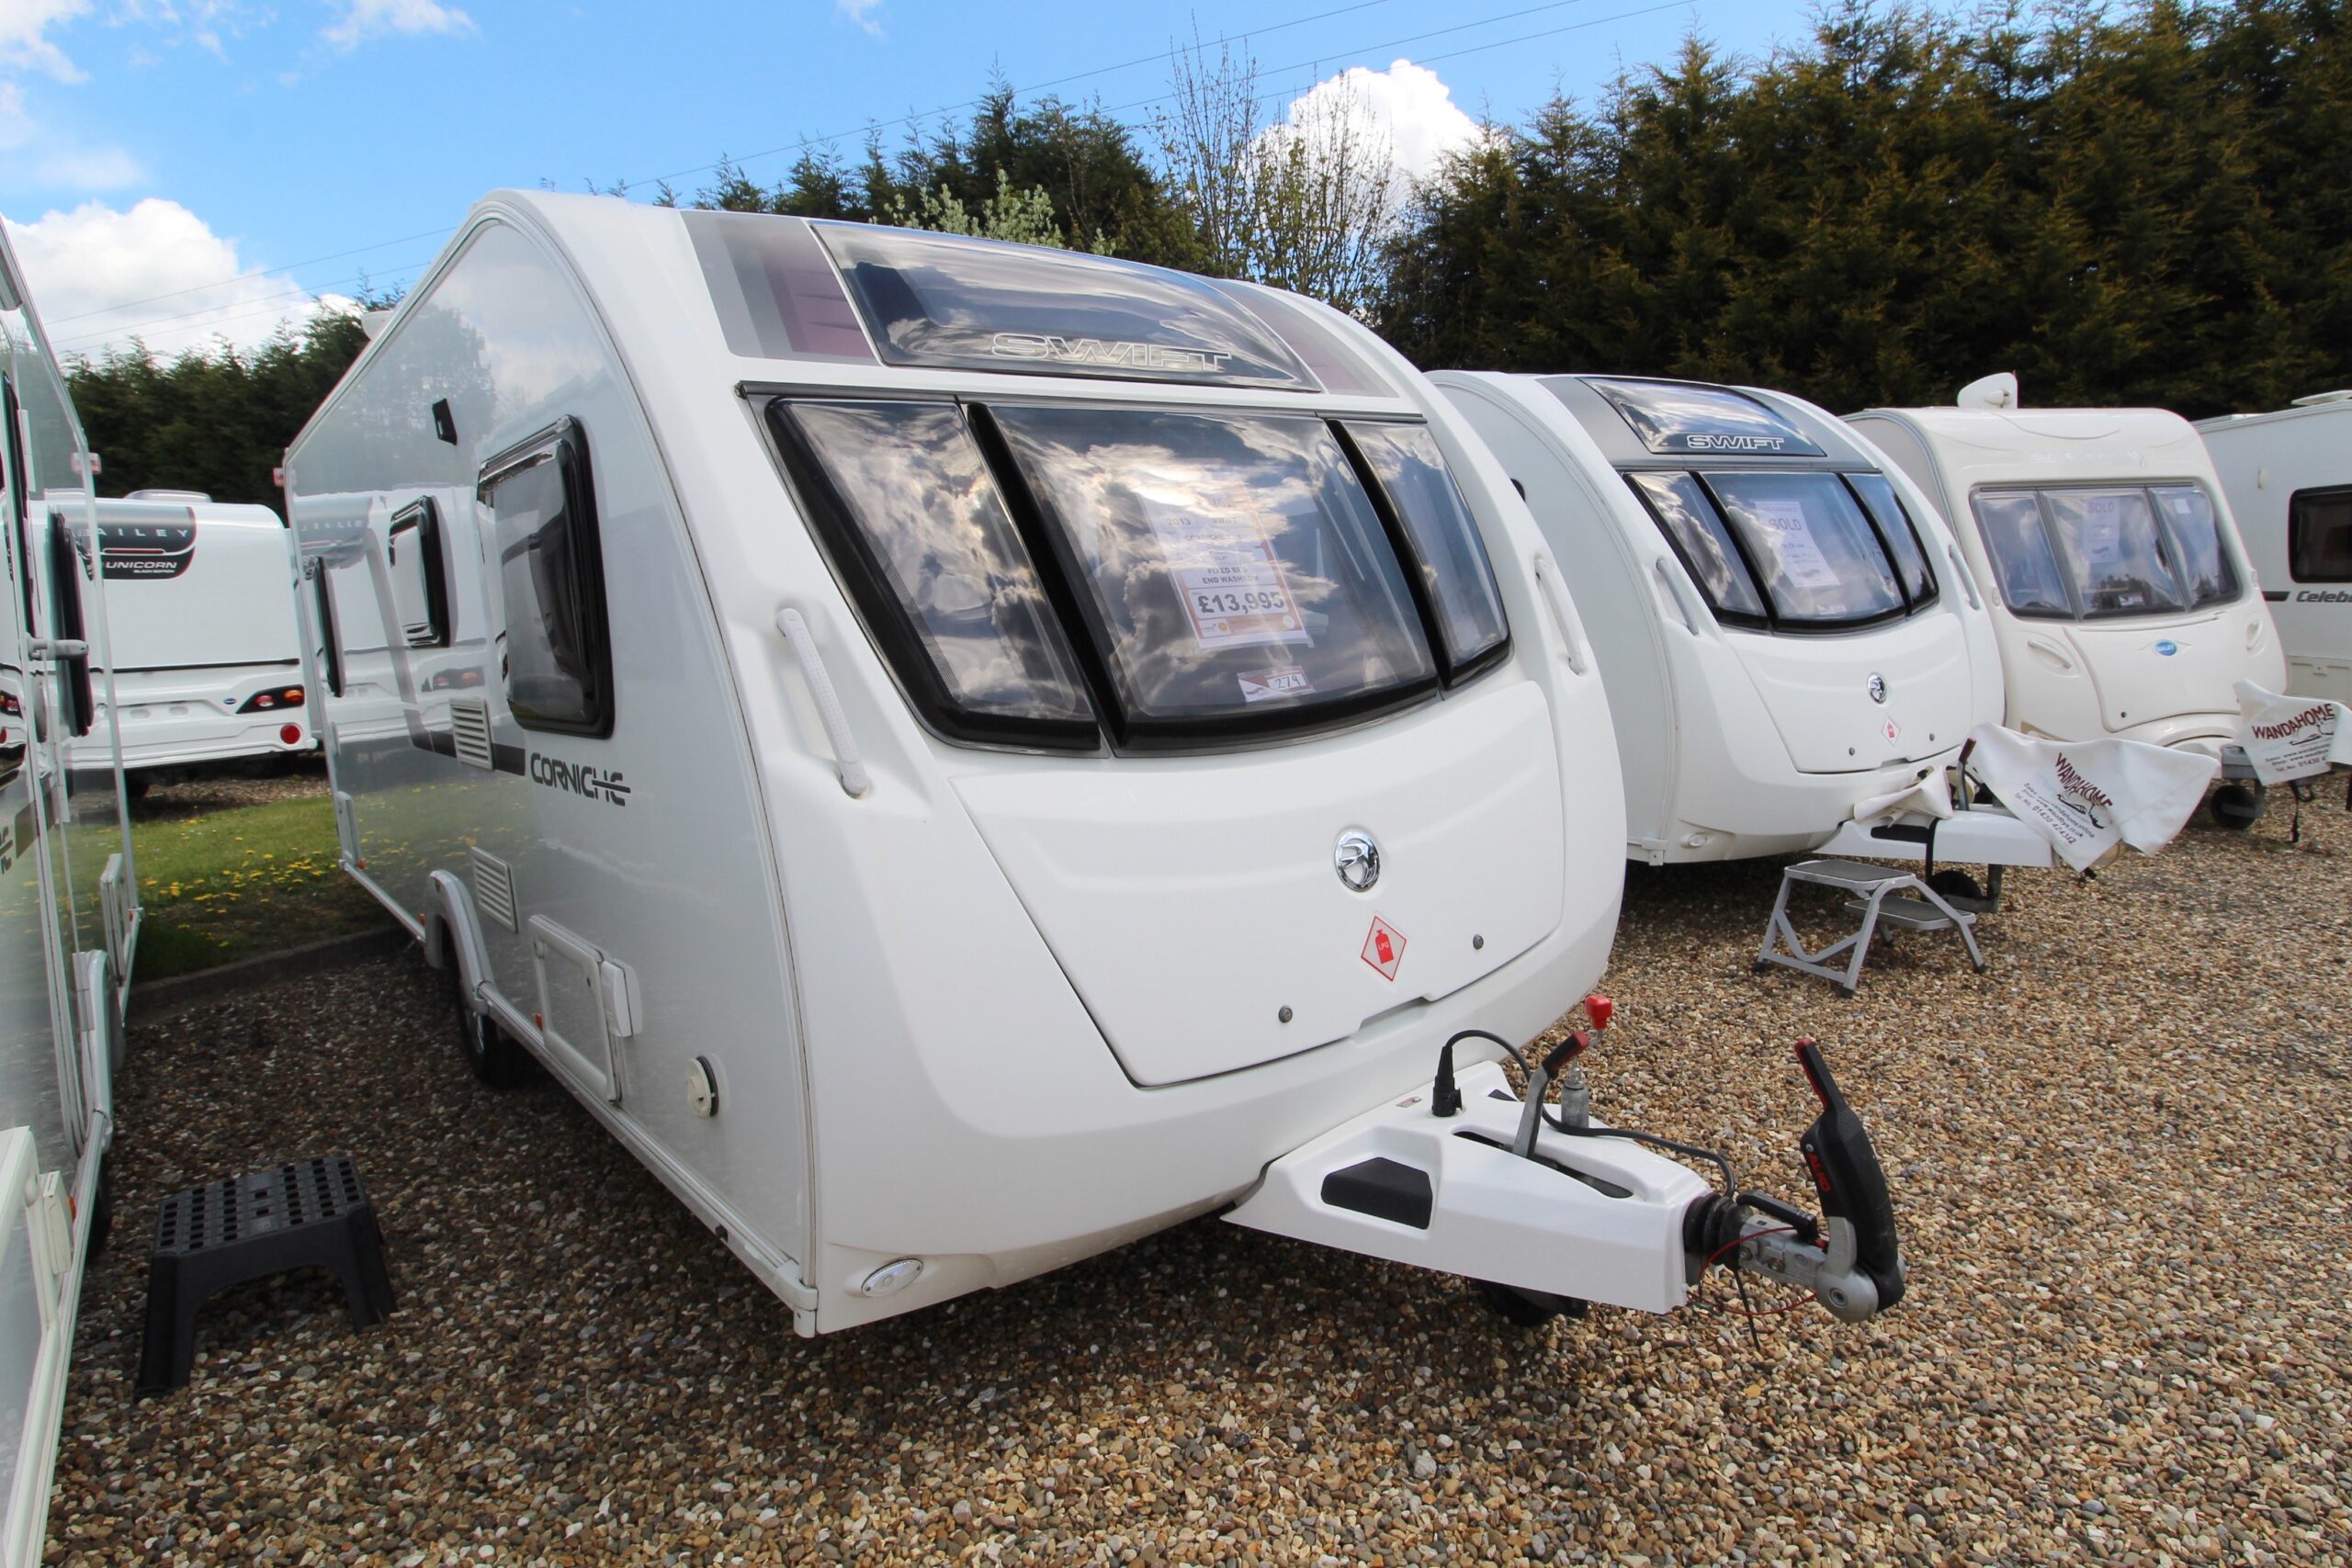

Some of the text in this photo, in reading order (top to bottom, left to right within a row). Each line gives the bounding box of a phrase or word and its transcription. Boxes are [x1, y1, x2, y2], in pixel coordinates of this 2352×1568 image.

[992, 333, 1233, 373] SWIFT
[1687, 434, 1785, 450] SWIFT
[2087, 502, 2115, 513] SOLD
[1768, 517, 1803, 531] SOLD
[97, 528, 188, 537] AILEY
[1206, 567, 1231, 575] FIXED
[1197, 591, 1285, 615] £13,995
[2296, 591, 2352, 604] Celeb
[1274, 674, 1301, 689] 279
[2252, 703, 2335, 740] WANDAHOME
[530, 751, 631, 807] CORNICHE
[2032, 805, 2054, 824] 01430
[1378, 941, 1390, 951] LPG
